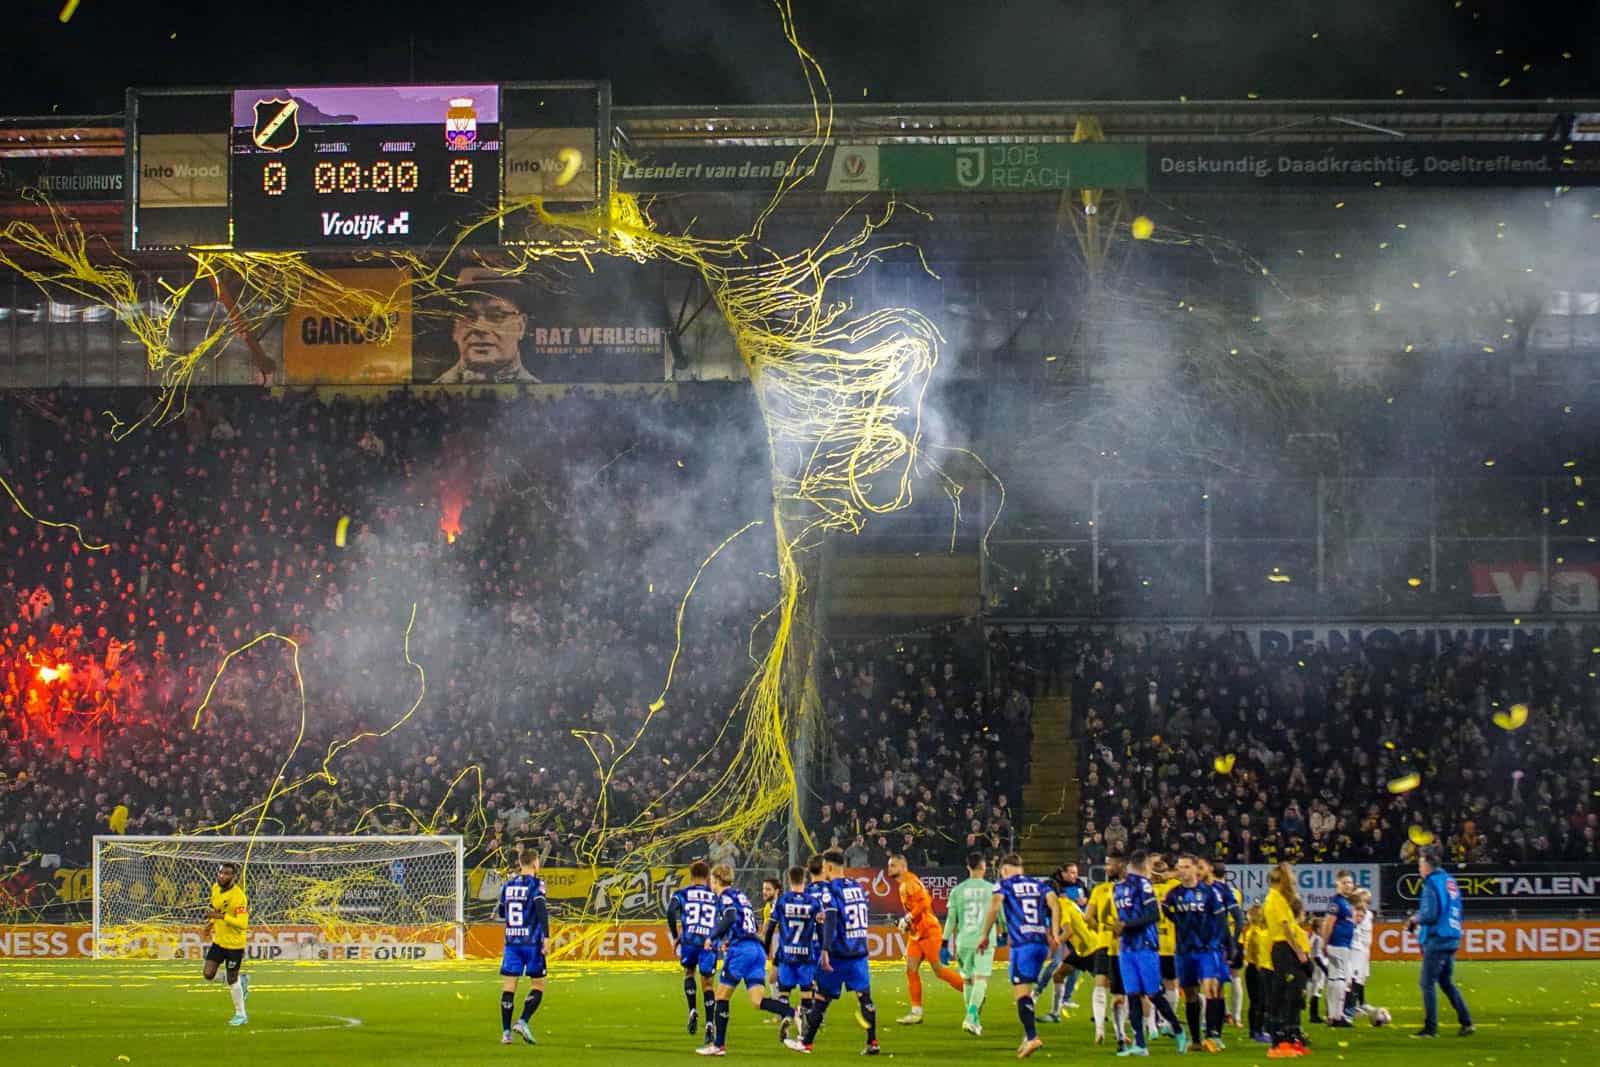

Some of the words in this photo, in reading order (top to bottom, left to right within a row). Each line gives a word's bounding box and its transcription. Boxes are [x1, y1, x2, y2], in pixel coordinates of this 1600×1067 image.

[992, 147, 1040, 166] JOB
[1160, 157, 1273, 177] Deskundig.
[1278, 156, 1420, 177] Daadkrachtig.
[1424, 156, 1552, 172] Doeltreffend.
[263, 162, 287, 196] 0
[314, 161, 419, 194] 00:00
[449, 159, 474, 193] 0
[992, 167, 1070, 187] REACH
[321, 211, 386, 240] Vrolijk
[535, 327, 572, 345] RAT
[577, 327, 661, 345] VERLEGH
[508, 902, 523, 926] 6
[685, 903, 717, 928] 33
[845, 903, 869, 930] 30
[1021, 899, 1040, 924] 5
[788, 921, 805, 945] 7
